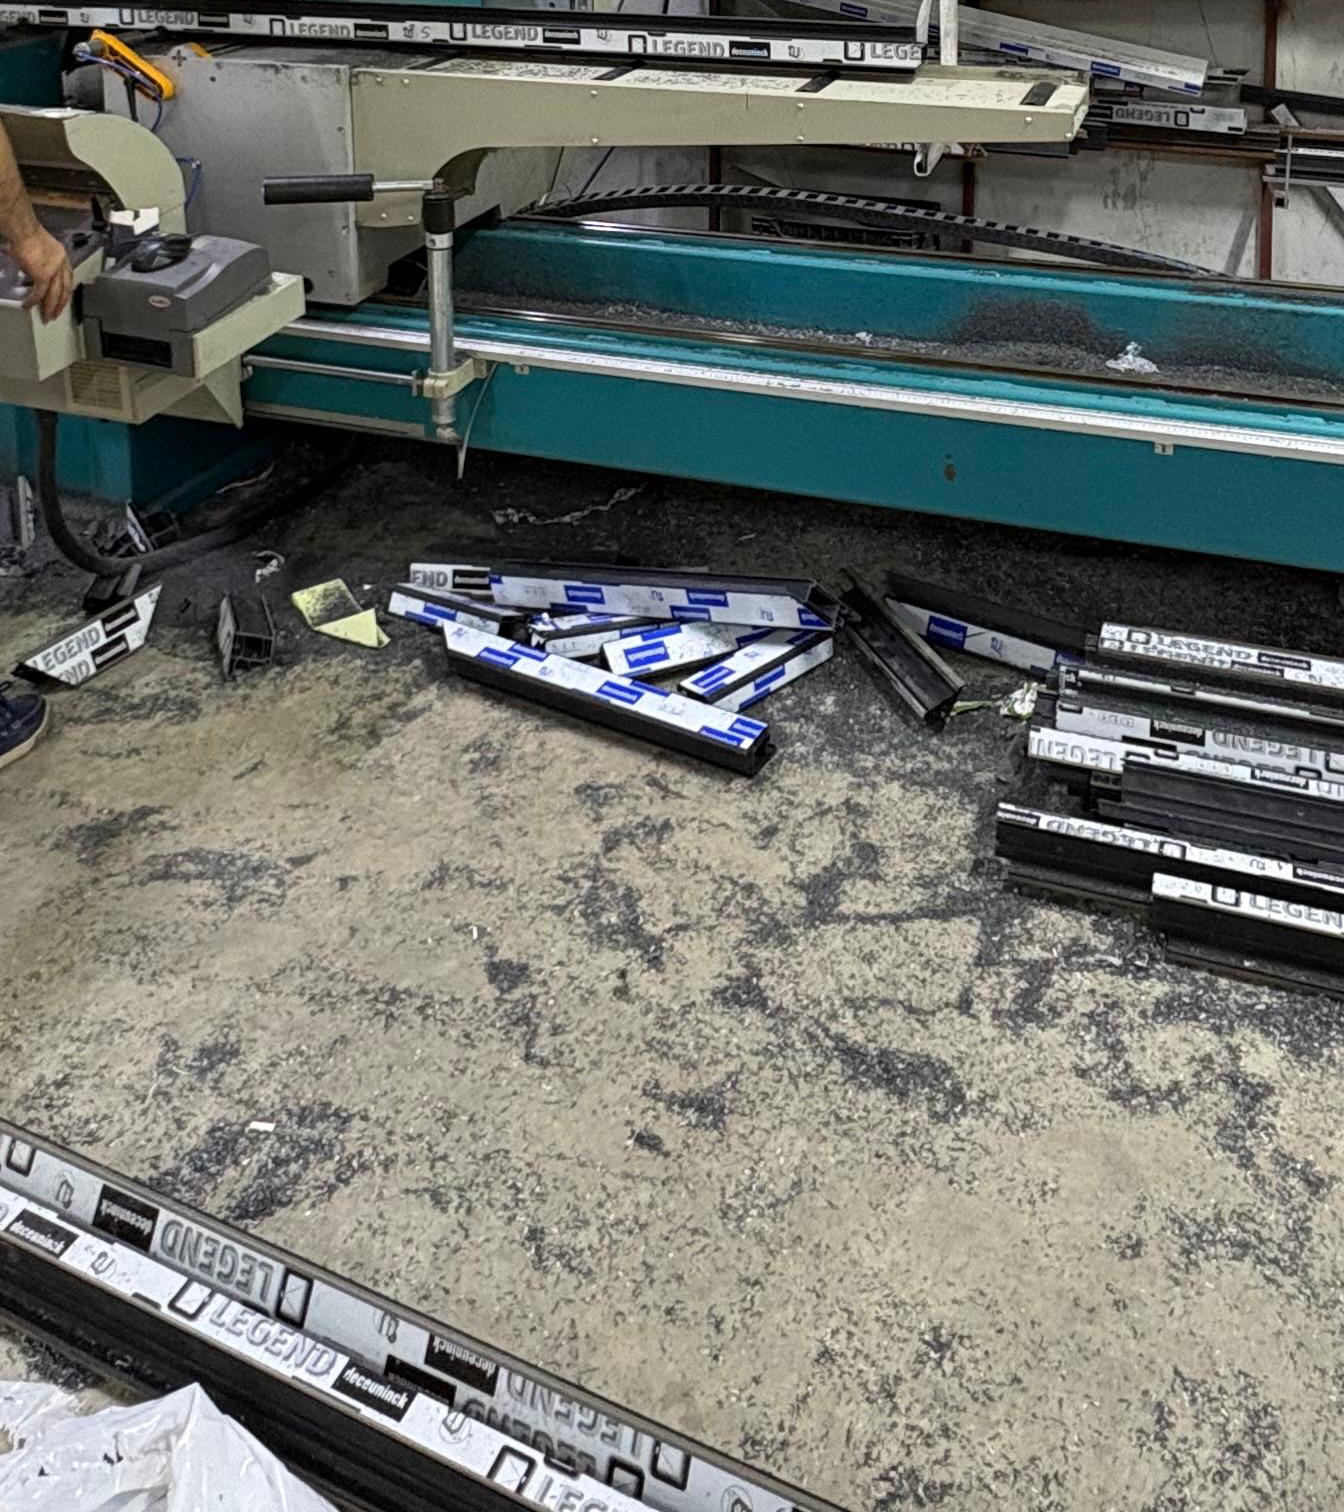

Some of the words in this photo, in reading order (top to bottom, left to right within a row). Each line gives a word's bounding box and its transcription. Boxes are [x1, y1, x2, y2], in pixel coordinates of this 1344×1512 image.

[137, 9, 194, 26] LEGEND
[289, 21, 350, 38] LEGEND
[472, 24, 538, 42] LEGEND
[653, 39, 724, 58] LEGEND
[1115, 107, 1170, 124] LEGEND
[33, 626, 101, 670] LEGEND
[1212, 729, 1317, 765] LEGEND
[160, 1220, 274, 1303] LEGEND
[209, 1296, 337, 1376] LEGEND
[343, 1365, 409, 1410] deceuninck
